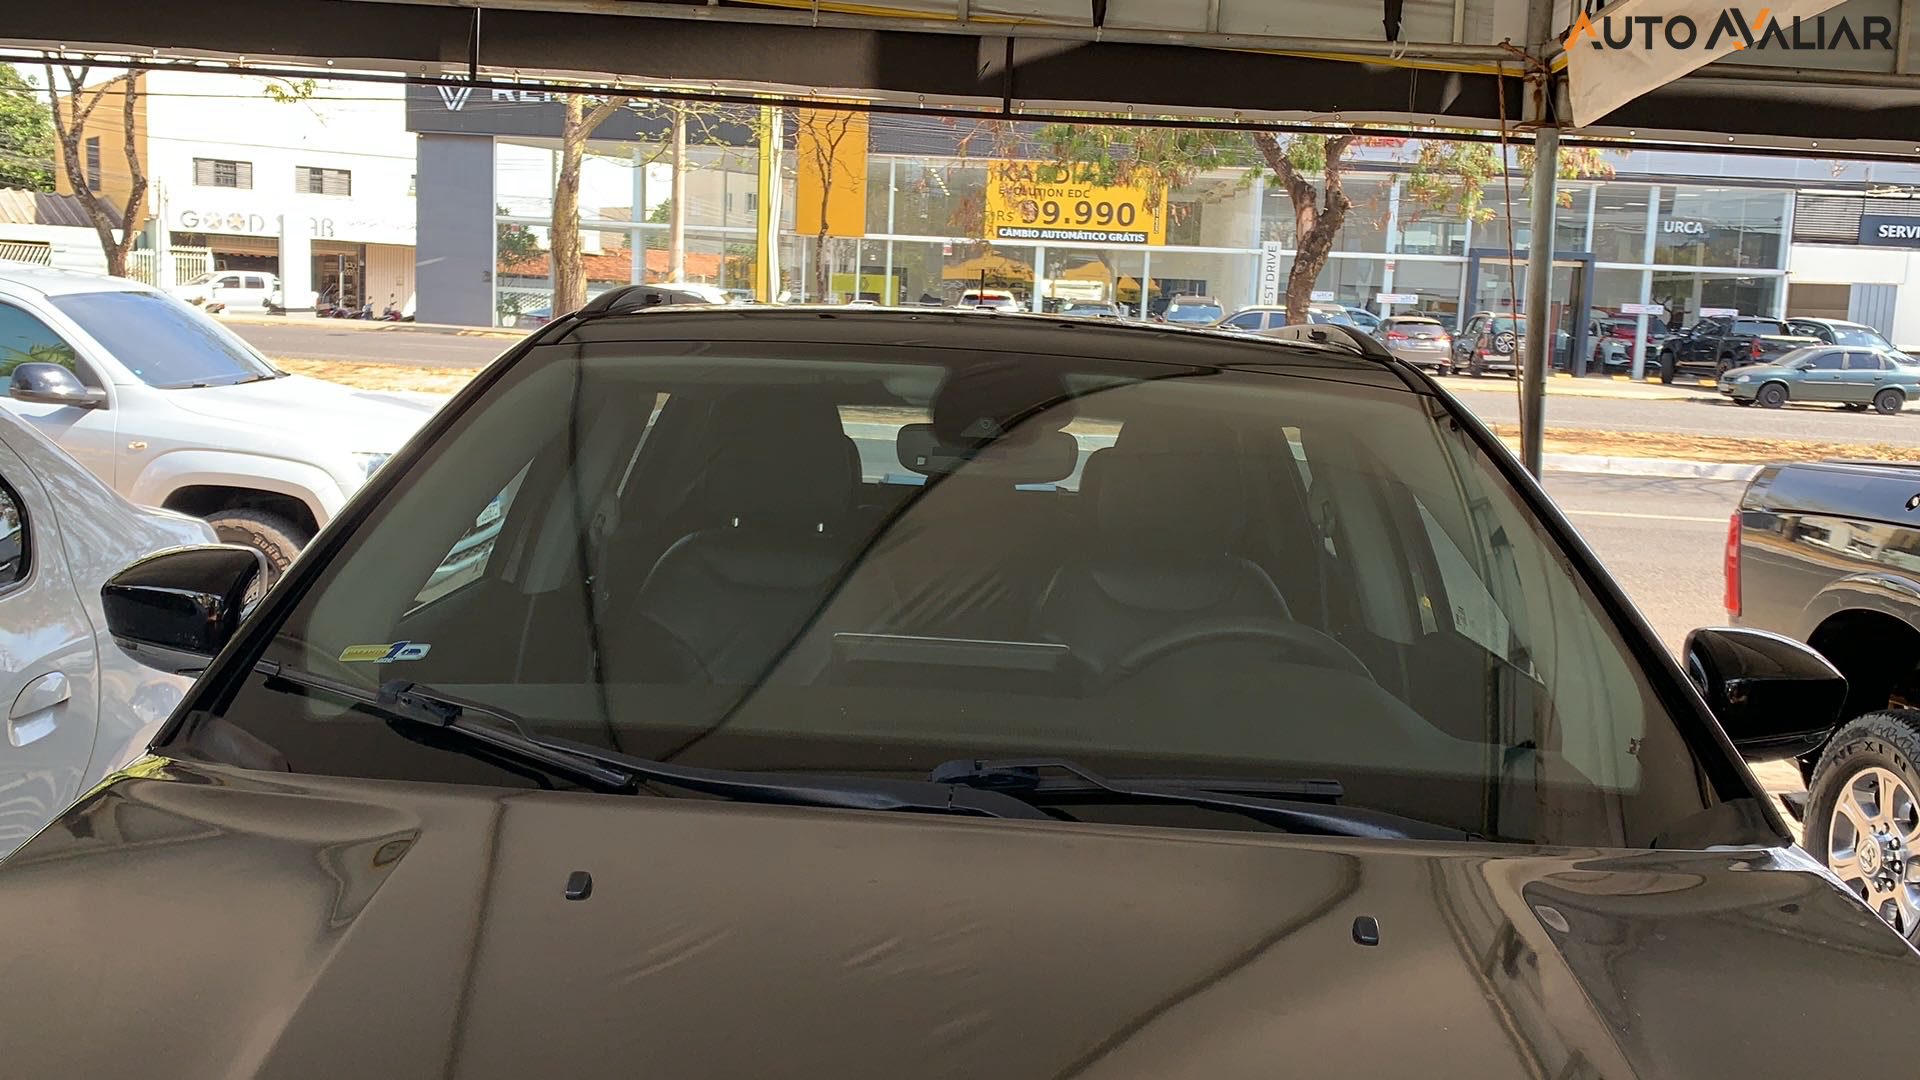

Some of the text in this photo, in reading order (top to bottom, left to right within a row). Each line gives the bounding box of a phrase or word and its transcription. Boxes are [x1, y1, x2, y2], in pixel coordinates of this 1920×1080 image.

[1068, 189, 1090, 199] EDC
[1663, 220, 1704, 234] URCA
[1040, 229, 1107, 241] AUTOMÁTICO
[1108, 231, 1145, 243] GRÁTIS
[1266, 245, 1278, 282] DRIVE
